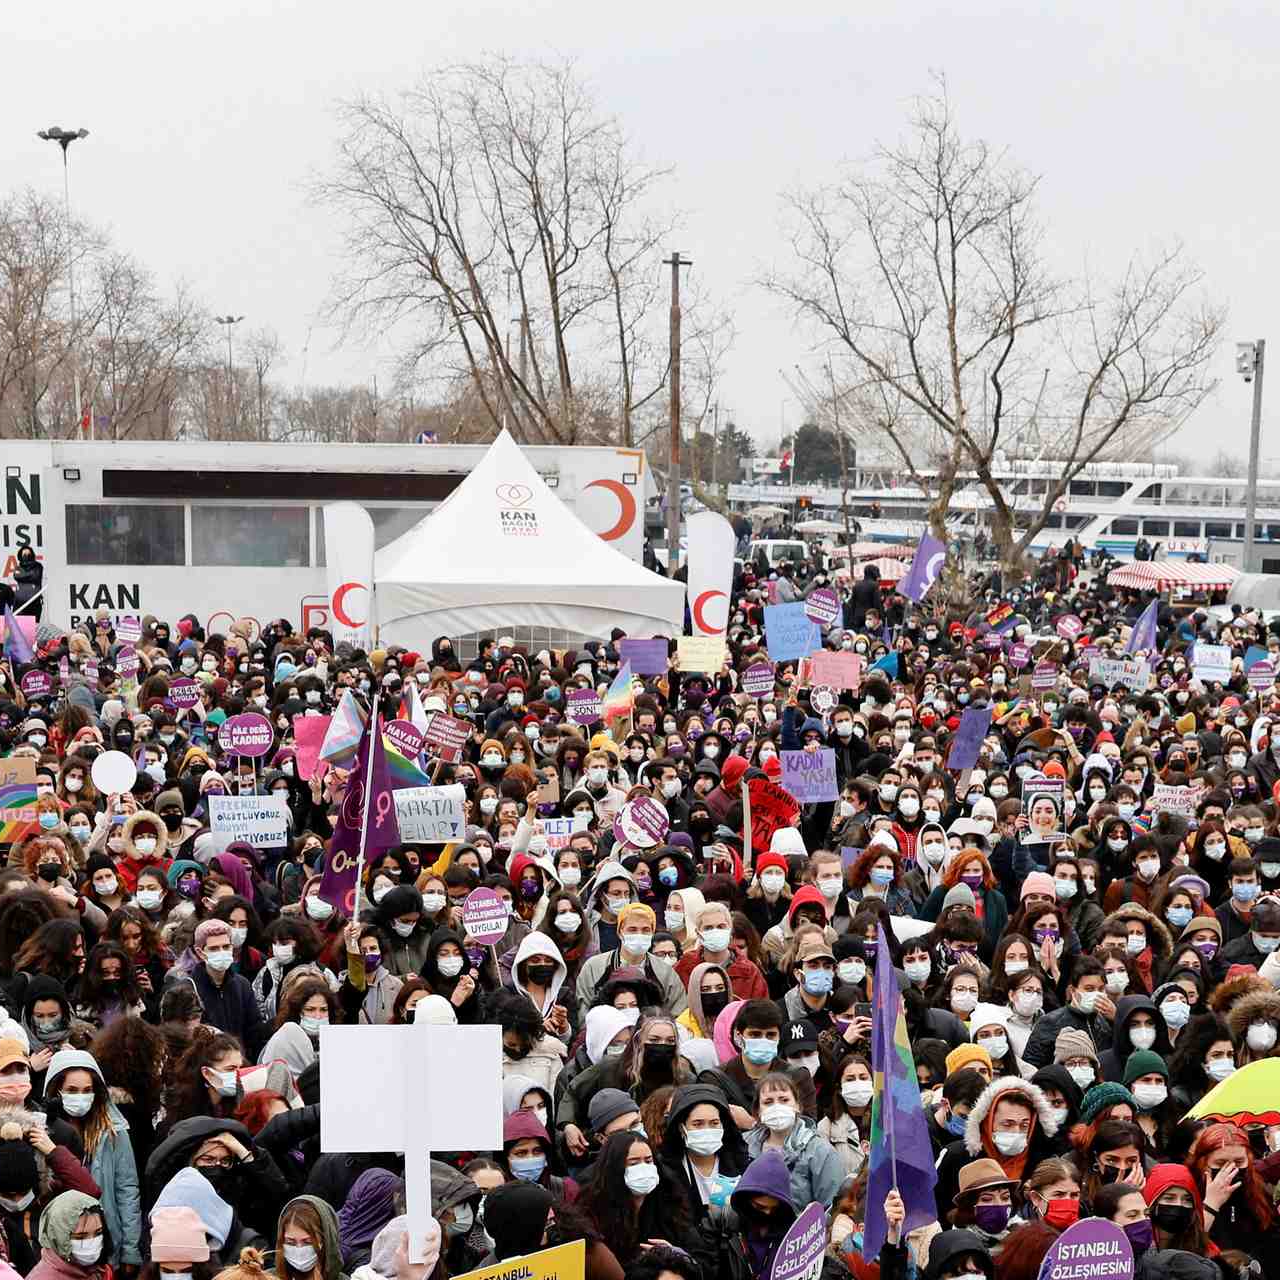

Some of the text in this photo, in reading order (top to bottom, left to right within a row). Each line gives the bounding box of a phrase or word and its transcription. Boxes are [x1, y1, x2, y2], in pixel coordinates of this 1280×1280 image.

[501, 512, 536, 521] KAN
[69, 583, 140, 609] KAN
[786, 752, 824, 772] KADIN
[470, 920, 505, 934] UYGULA!
[1058, 1240, 1123, 1260] İSTANBUL
[1050, 1257, 1131, 1280] ÖZLEŞMESİNİ
